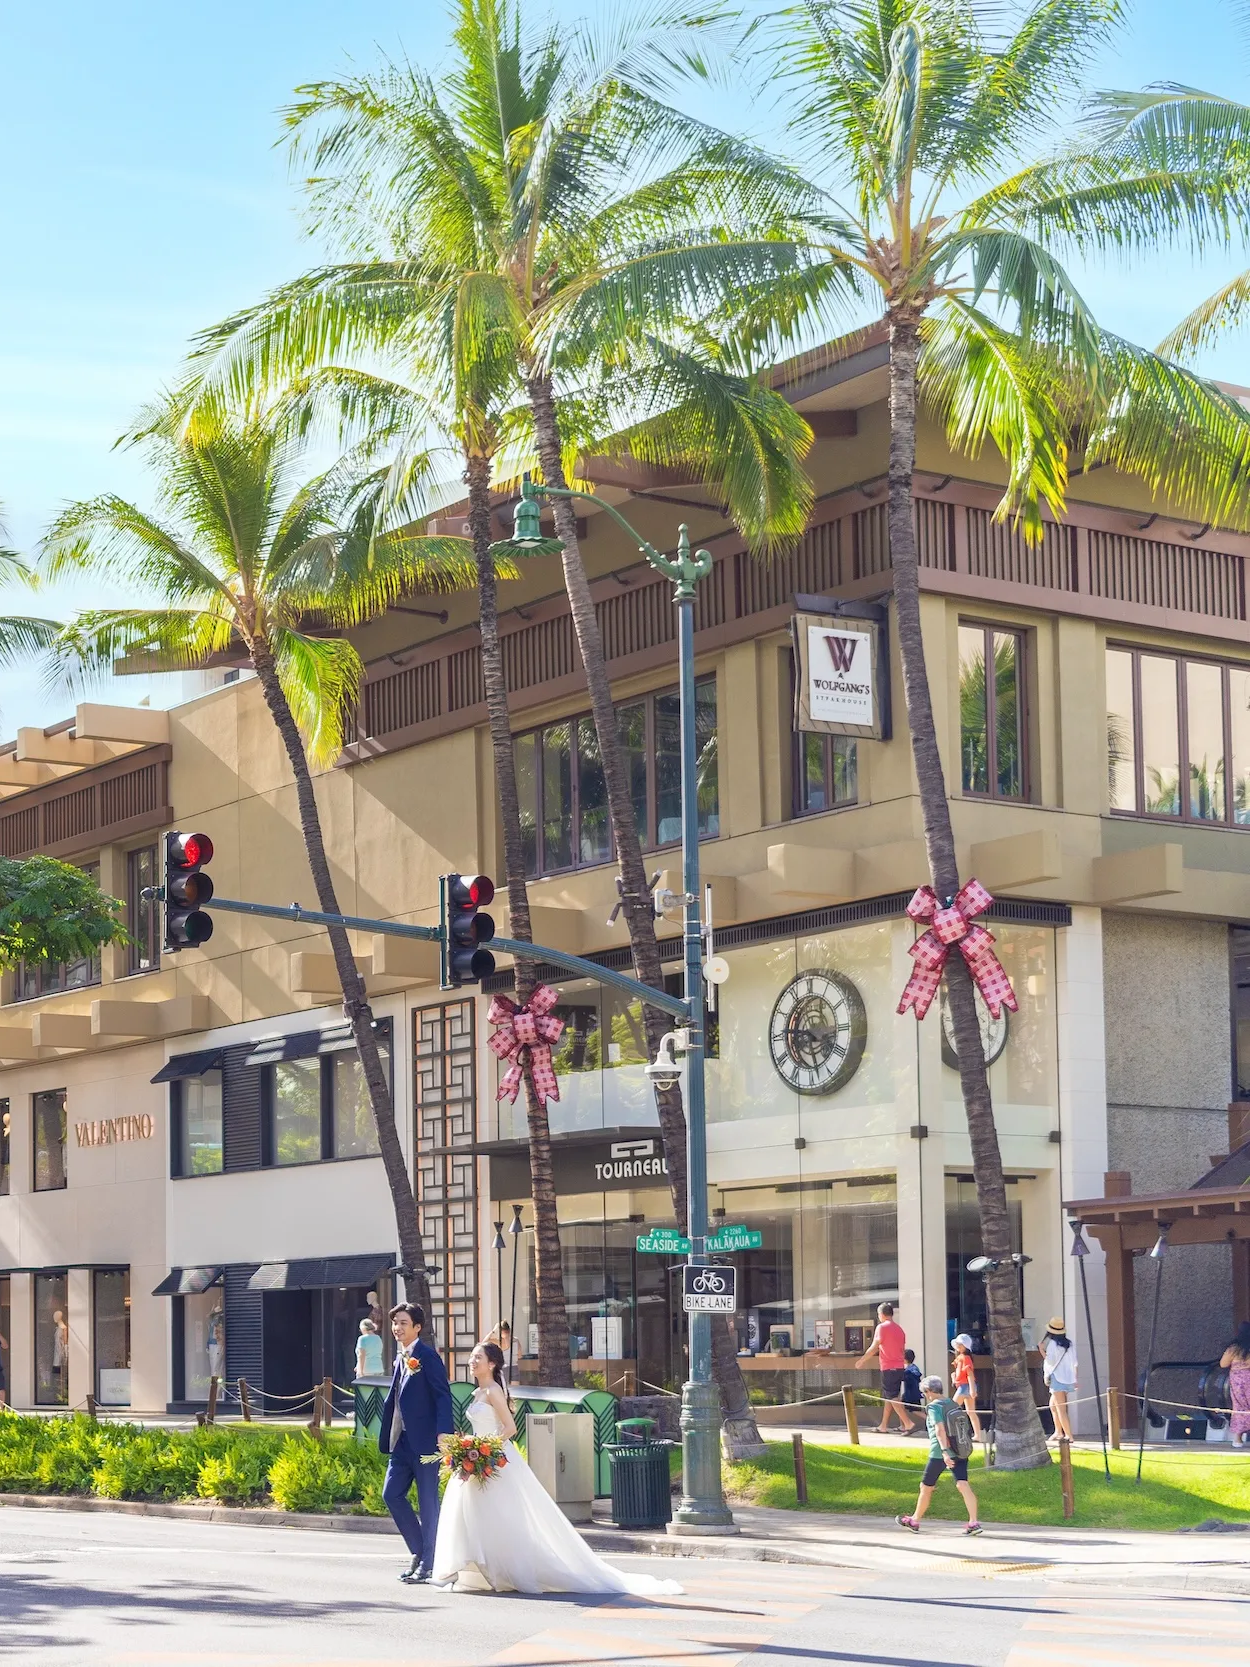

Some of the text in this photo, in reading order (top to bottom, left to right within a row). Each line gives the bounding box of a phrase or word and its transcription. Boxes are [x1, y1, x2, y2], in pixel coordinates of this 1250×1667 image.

[812, 679, 870, 695] WOLFGANG'S
[74, 1113, 152, 1148] VALENTINO
[639, 1238, 679, 1251] SEASIDE
[686, 1296, 732, 1309] BIKE LANE
